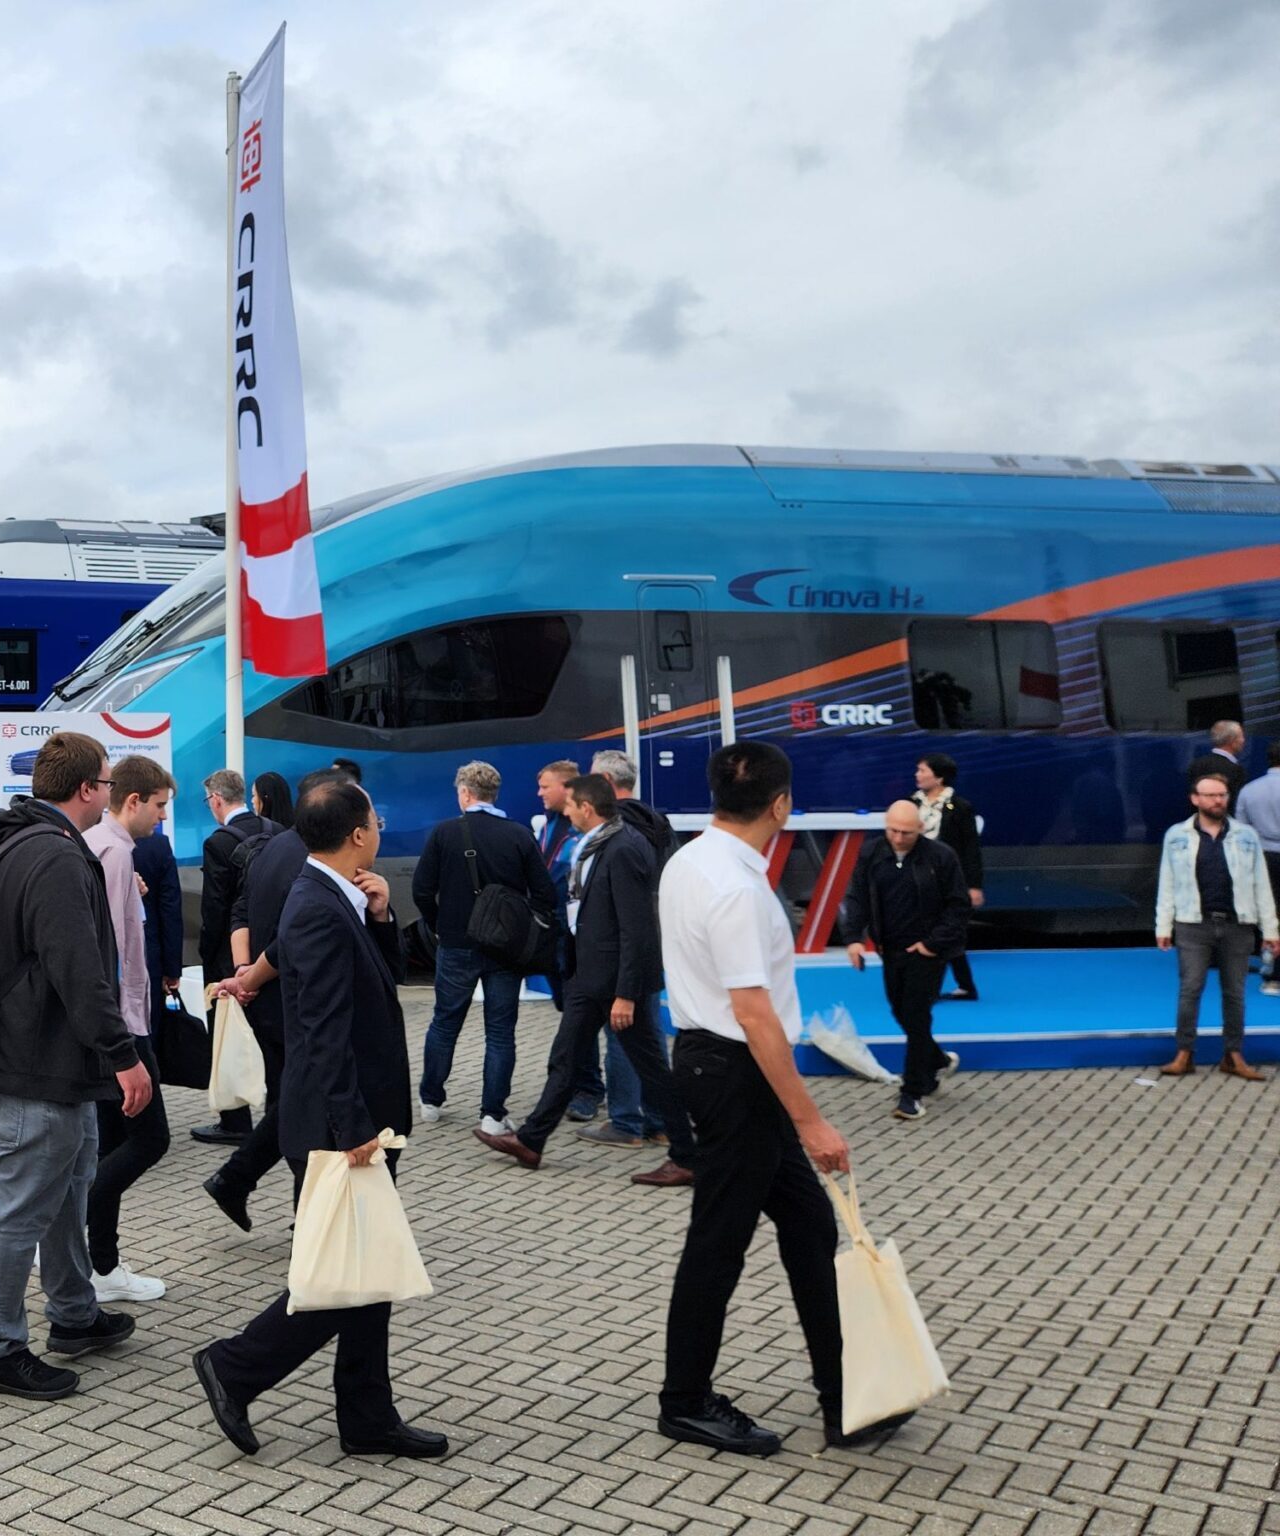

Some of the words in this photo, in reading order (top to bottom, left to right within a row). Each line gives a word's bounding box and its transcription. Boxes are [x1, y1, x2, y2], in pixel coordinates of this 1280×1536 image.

[235, 211, 263, 449] CRRC
[788, 585, 880, 608] Cinova
[821, 704, 893, 724] CRRC
[21, 726, 60, 736] CRRC
